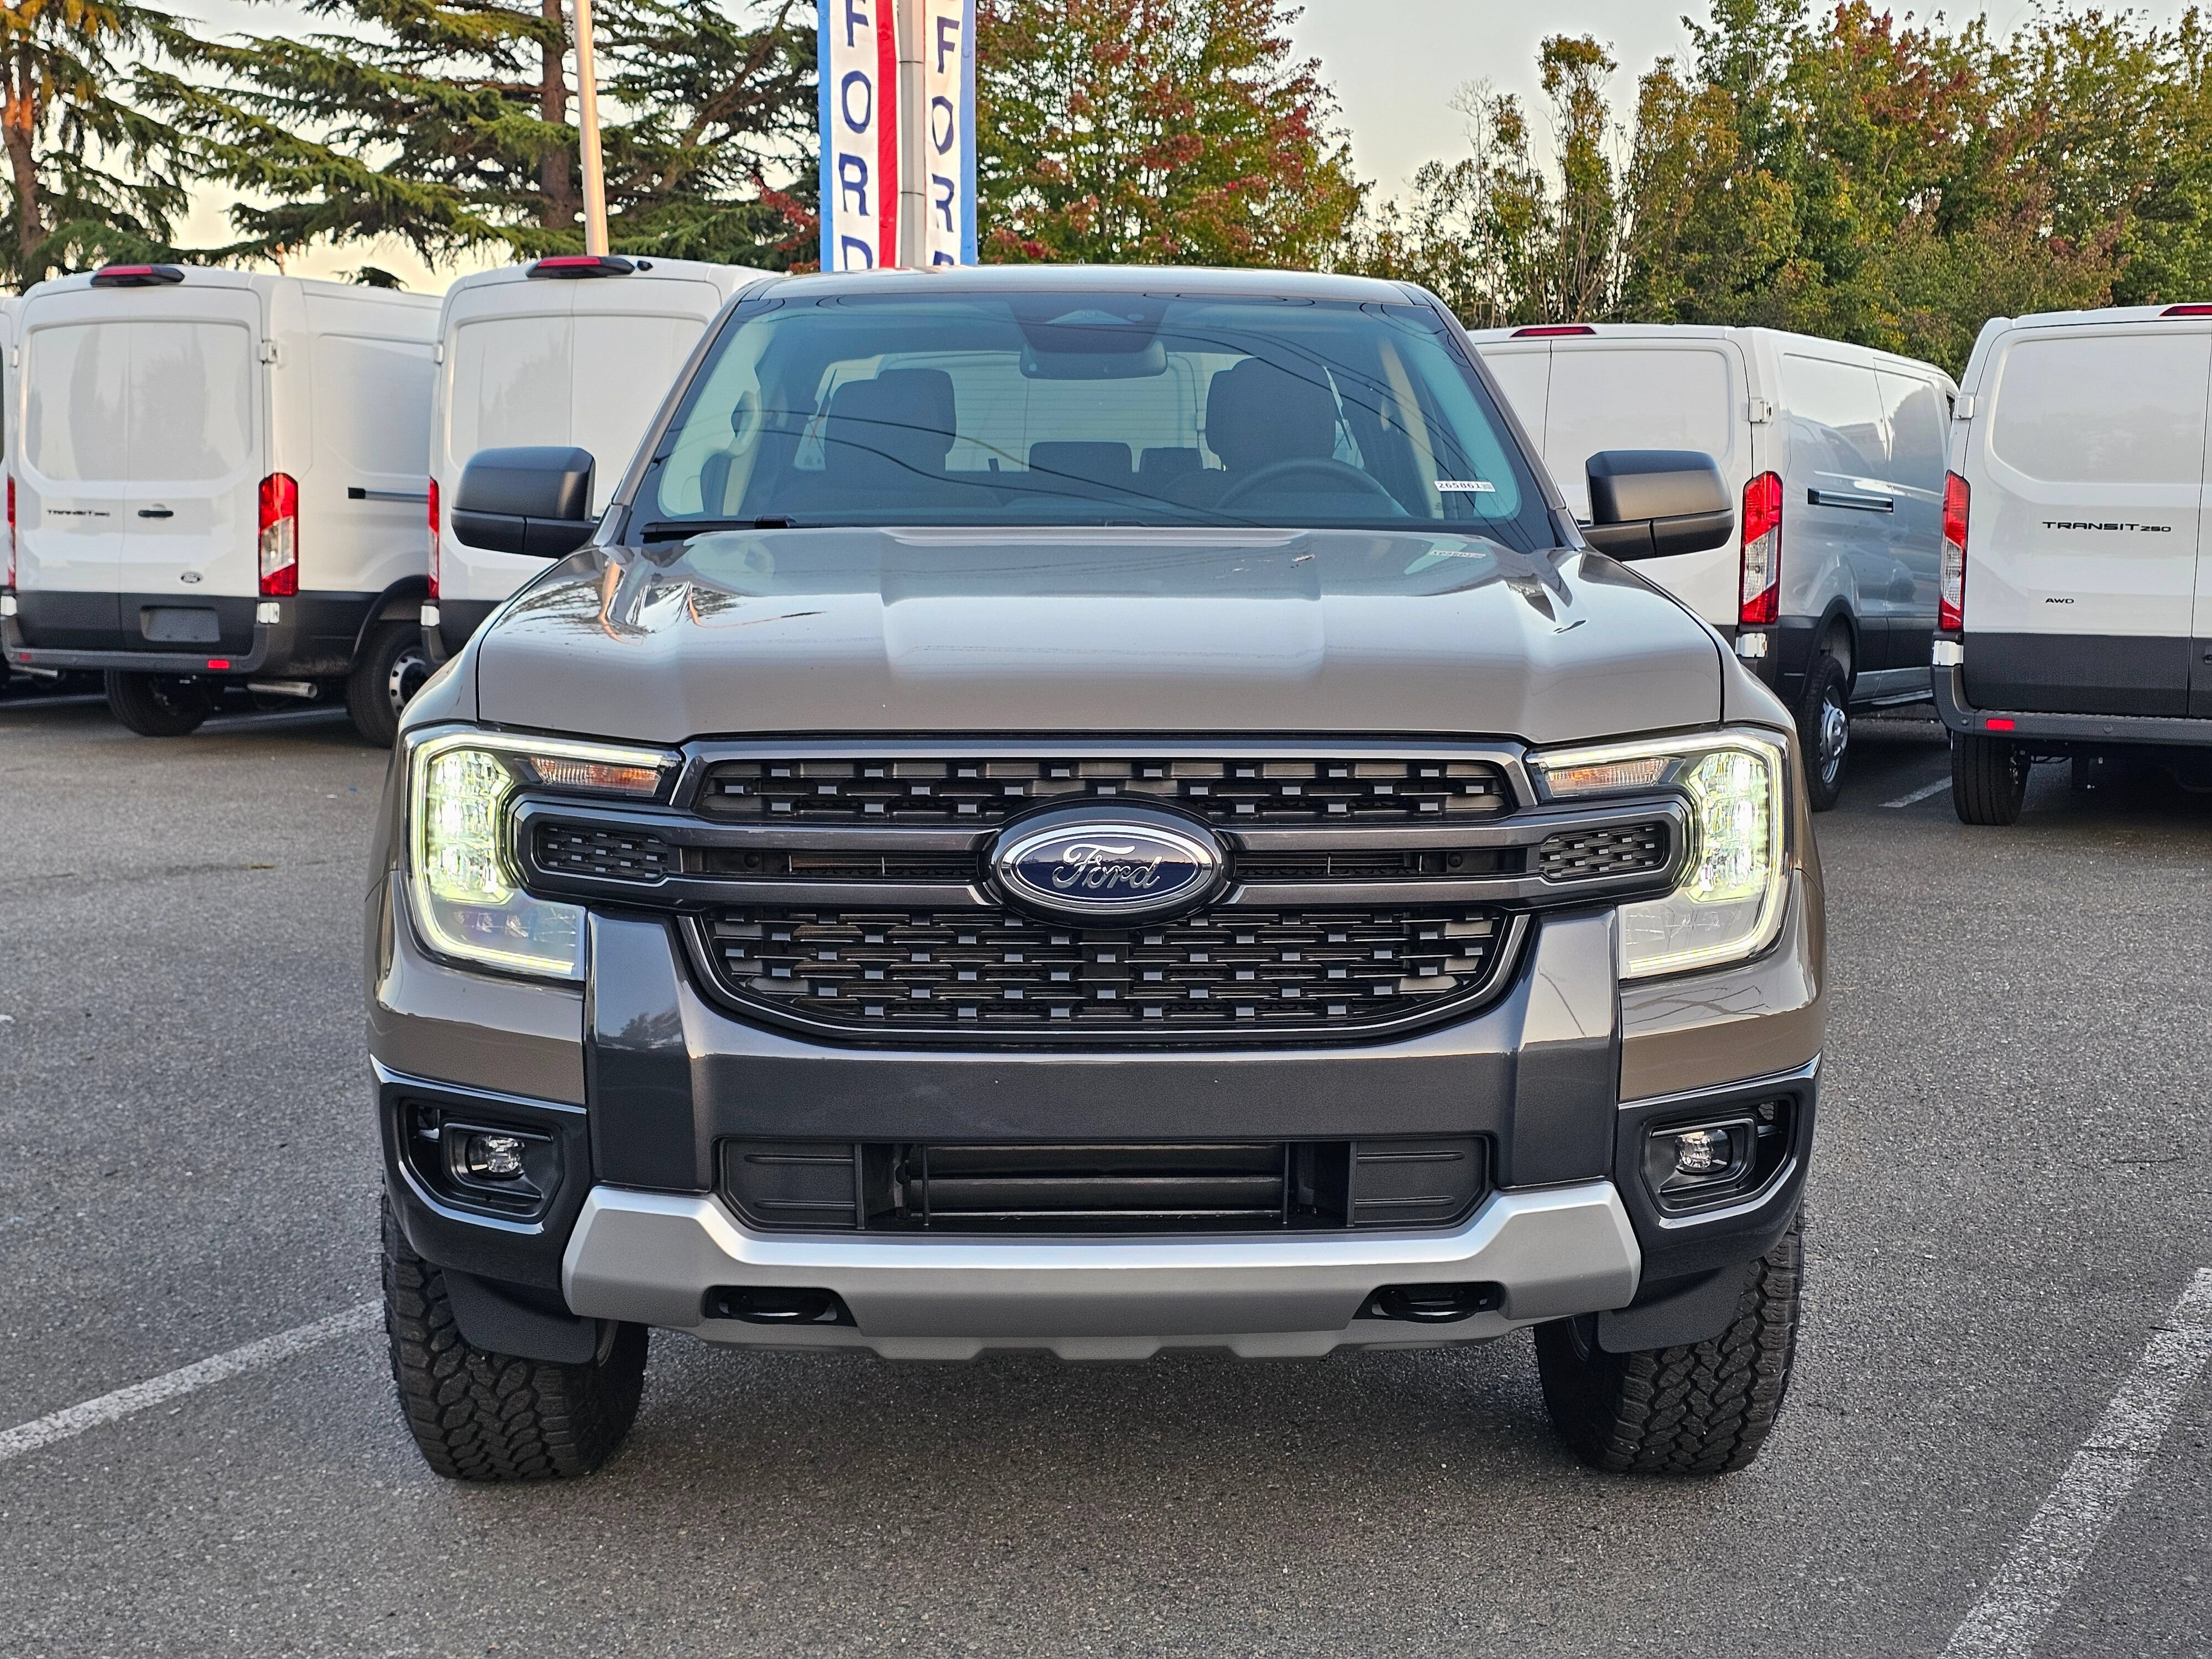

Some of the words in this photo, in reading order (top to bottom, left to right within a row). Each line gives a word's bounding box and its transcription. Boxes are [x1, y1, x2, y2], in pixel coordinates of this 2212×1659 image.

[932, 15, 960, 266] FOR
[2042, 521, 2140, 530] TRANSIT
[1052, 843, 1163, 889] Ford
